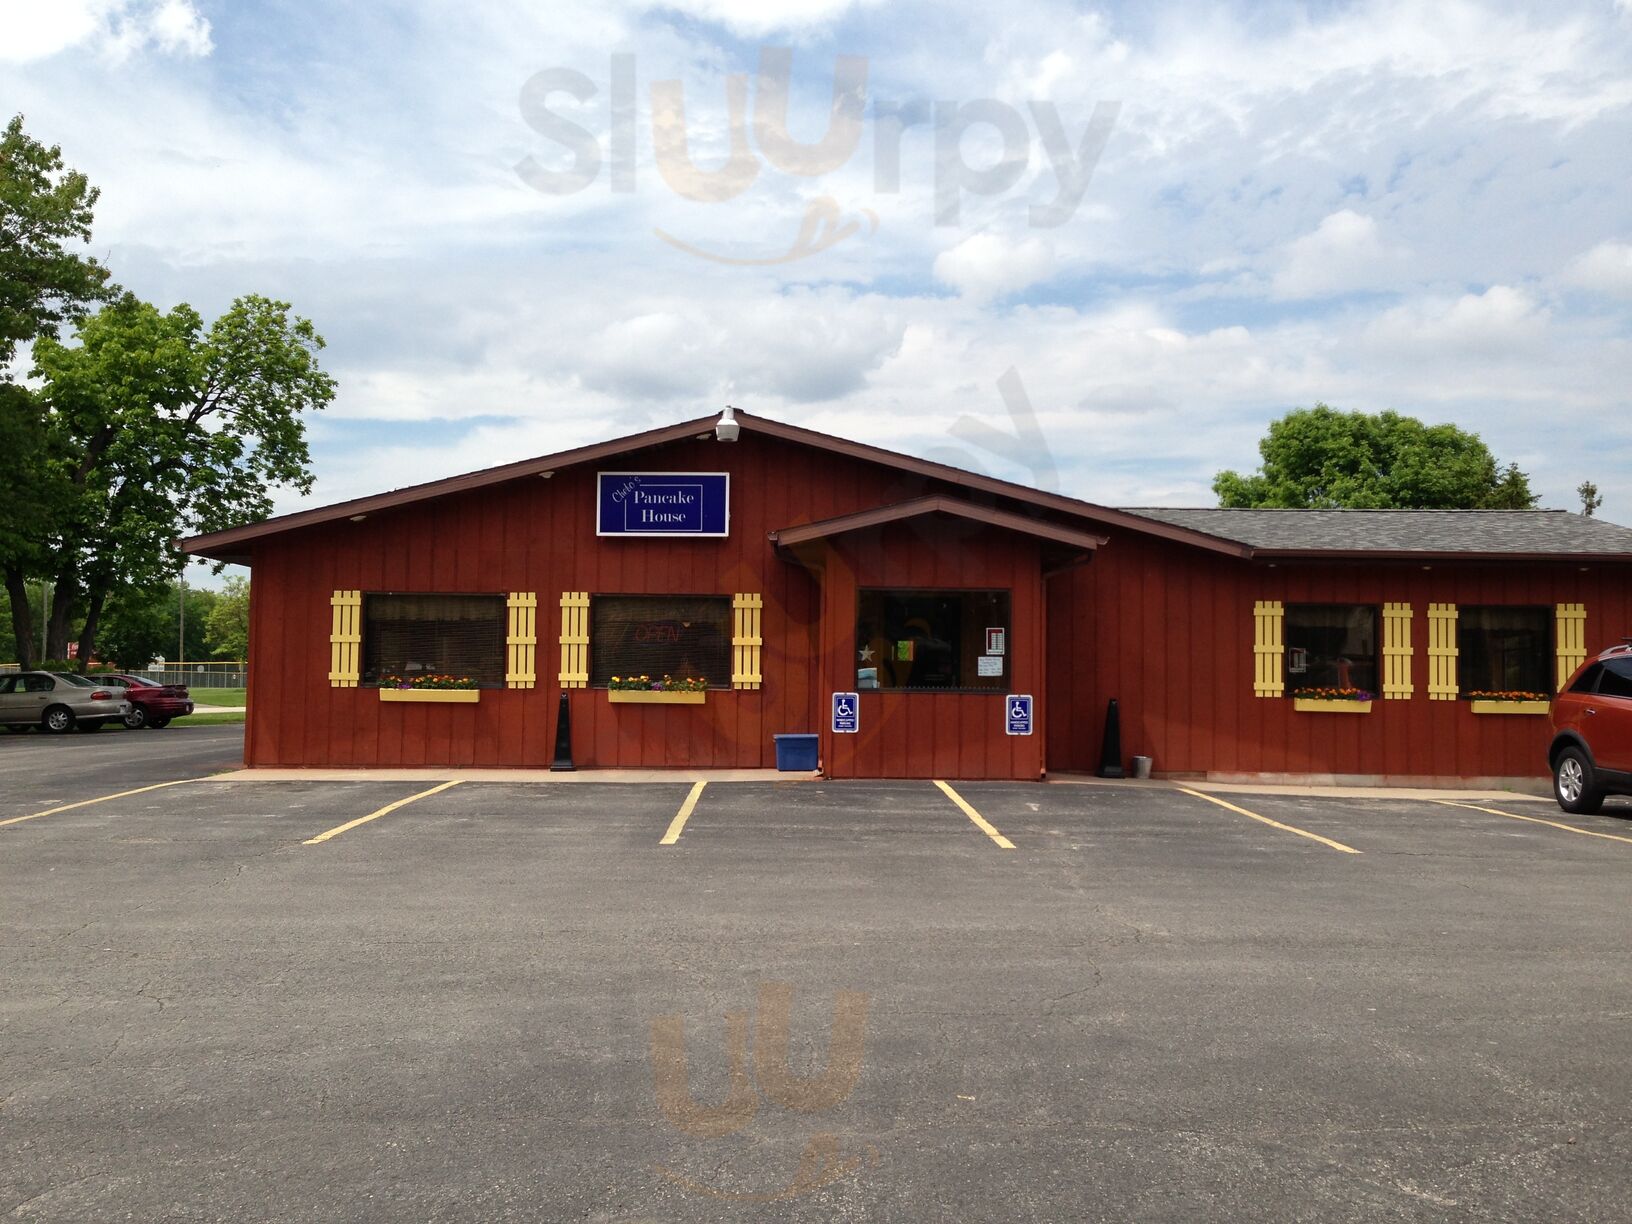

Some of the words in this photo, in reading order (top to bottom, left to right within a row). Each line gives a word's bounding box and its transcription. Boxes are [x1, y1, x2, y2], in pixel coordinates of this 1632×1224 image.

[634, 490, 695, 504] Pancake
[642, 509, 687, 523] House
[634, 623, 681, 642] OPEN
